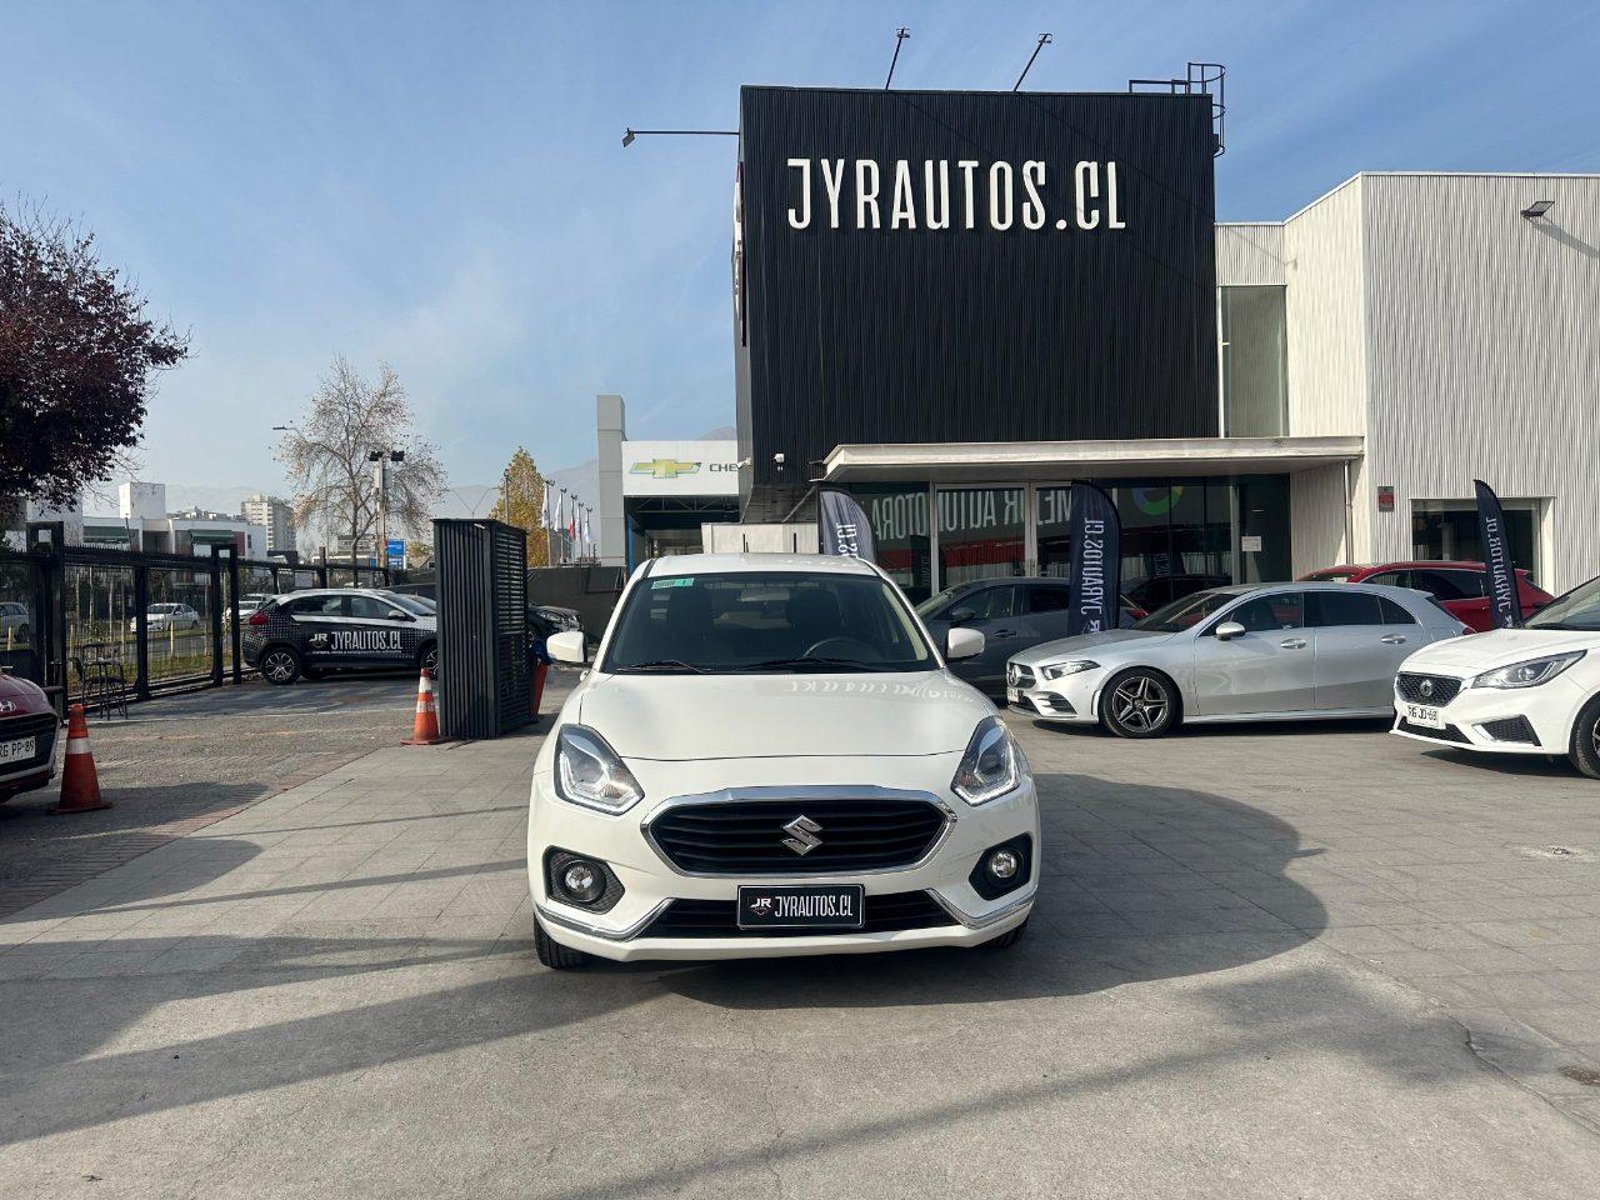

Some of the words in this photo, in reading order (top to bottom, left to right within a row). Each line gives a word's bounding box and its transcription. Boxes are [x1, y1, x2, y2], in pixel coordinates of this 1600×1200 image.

[787, 158, 1126, 230] JYRAUTOS.CL
[709, 463, 740, 472] CHE
[309, 633, 328, 642] JR
[331, 631, 403, 650] JYRAUTOS.CL
[750, 898, 772, 908] JR
[774, 894, 853, 917] JYRAUTOS.CL
